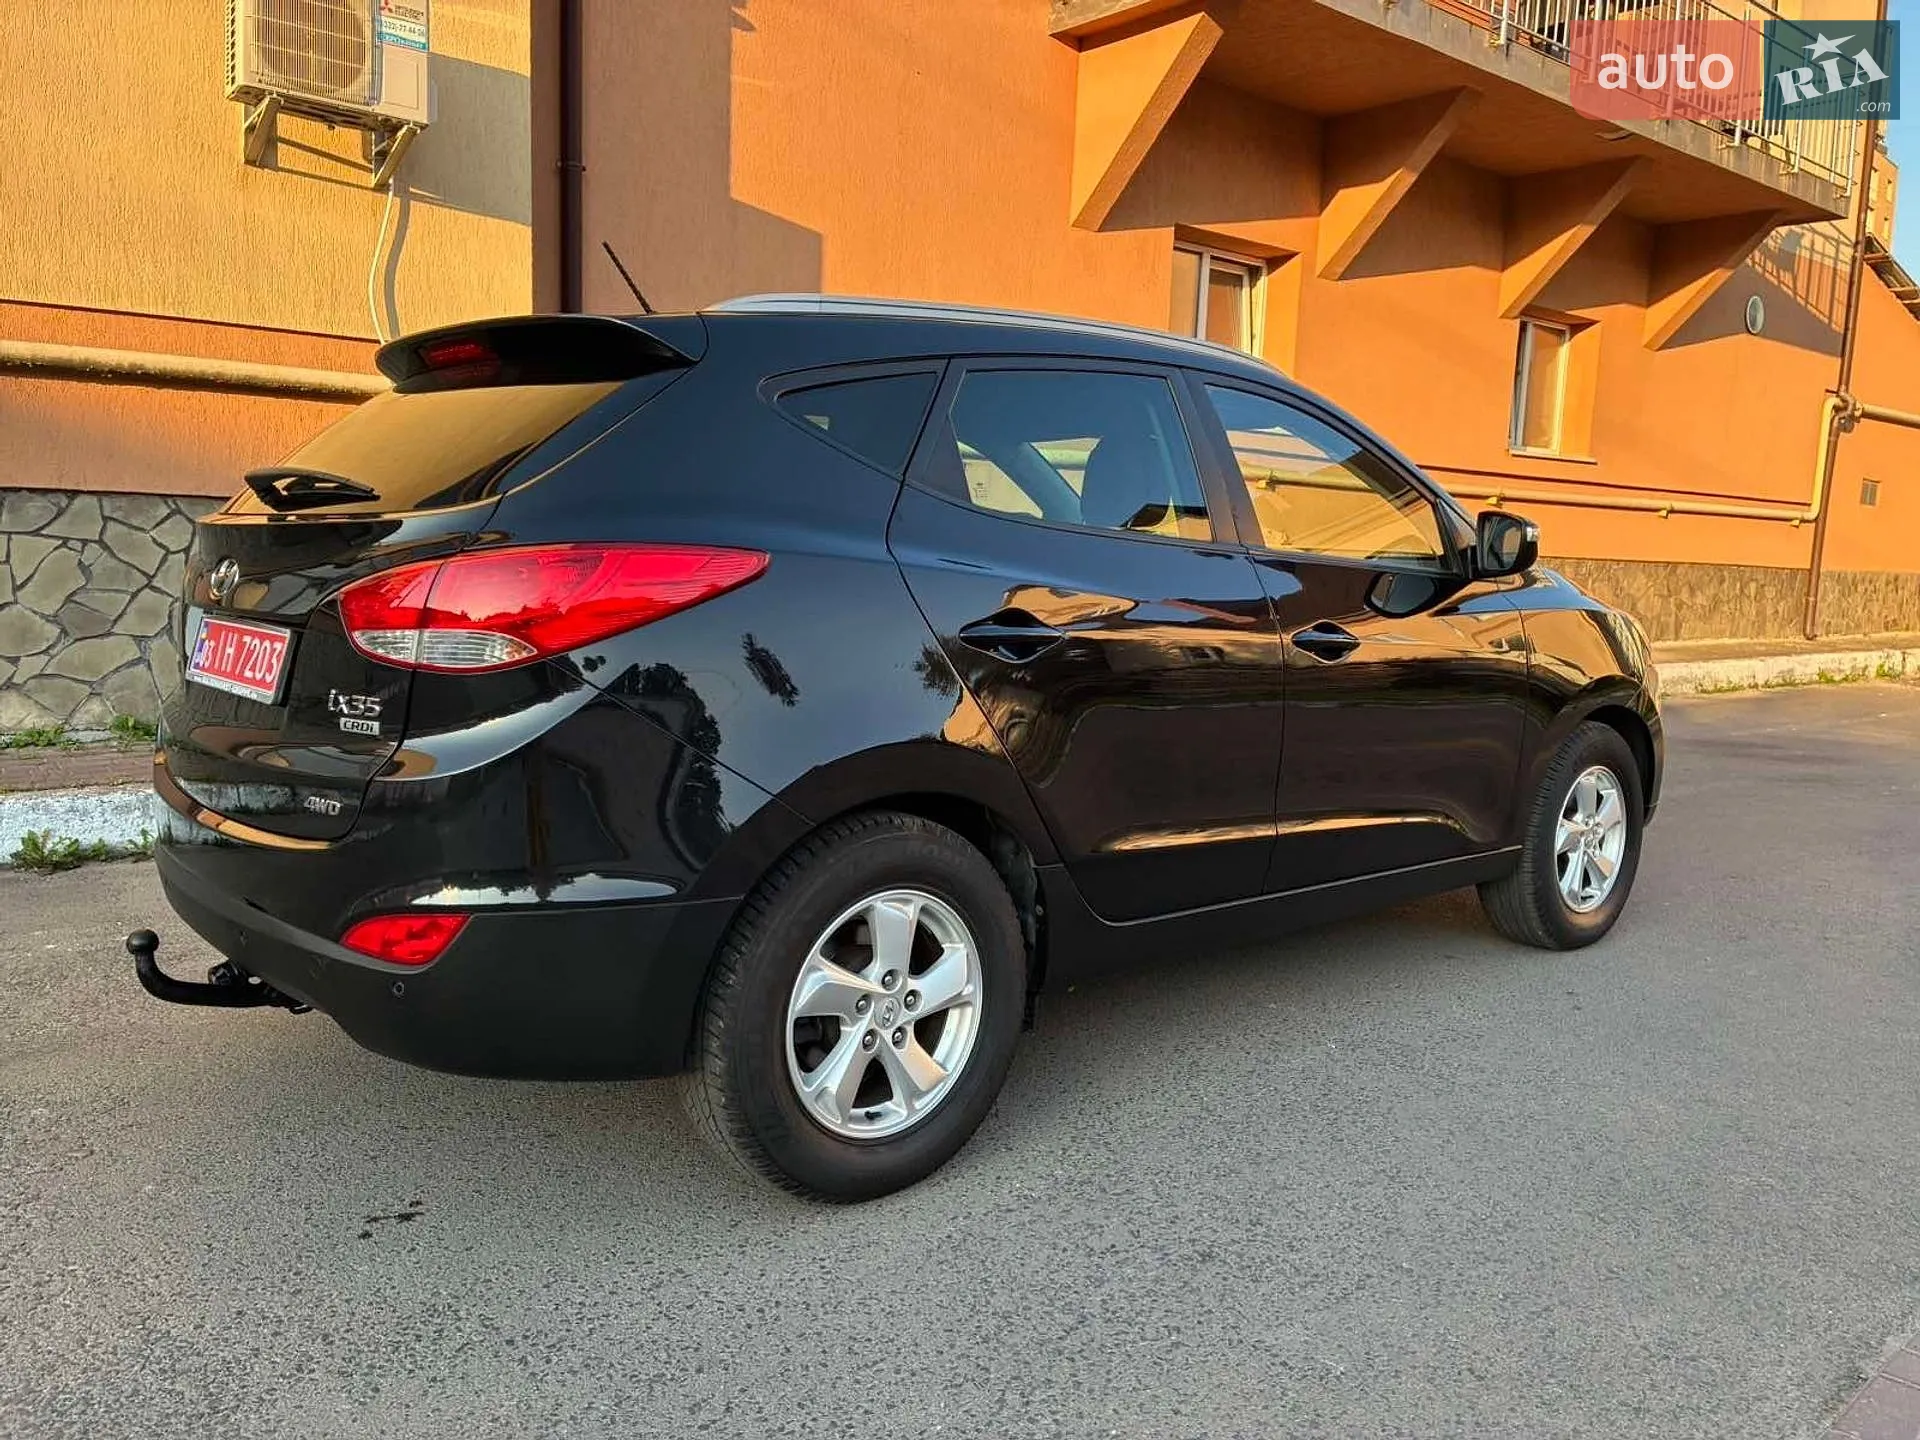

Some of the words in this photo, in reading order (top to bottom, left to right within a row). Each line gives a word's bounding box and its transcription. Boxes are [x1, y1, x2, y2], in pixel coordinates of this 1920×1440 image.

[235, 635, 283, 683] 7203
[328, 689, 383, 717] ix35
[304, 796, 341, 815] 4WD
